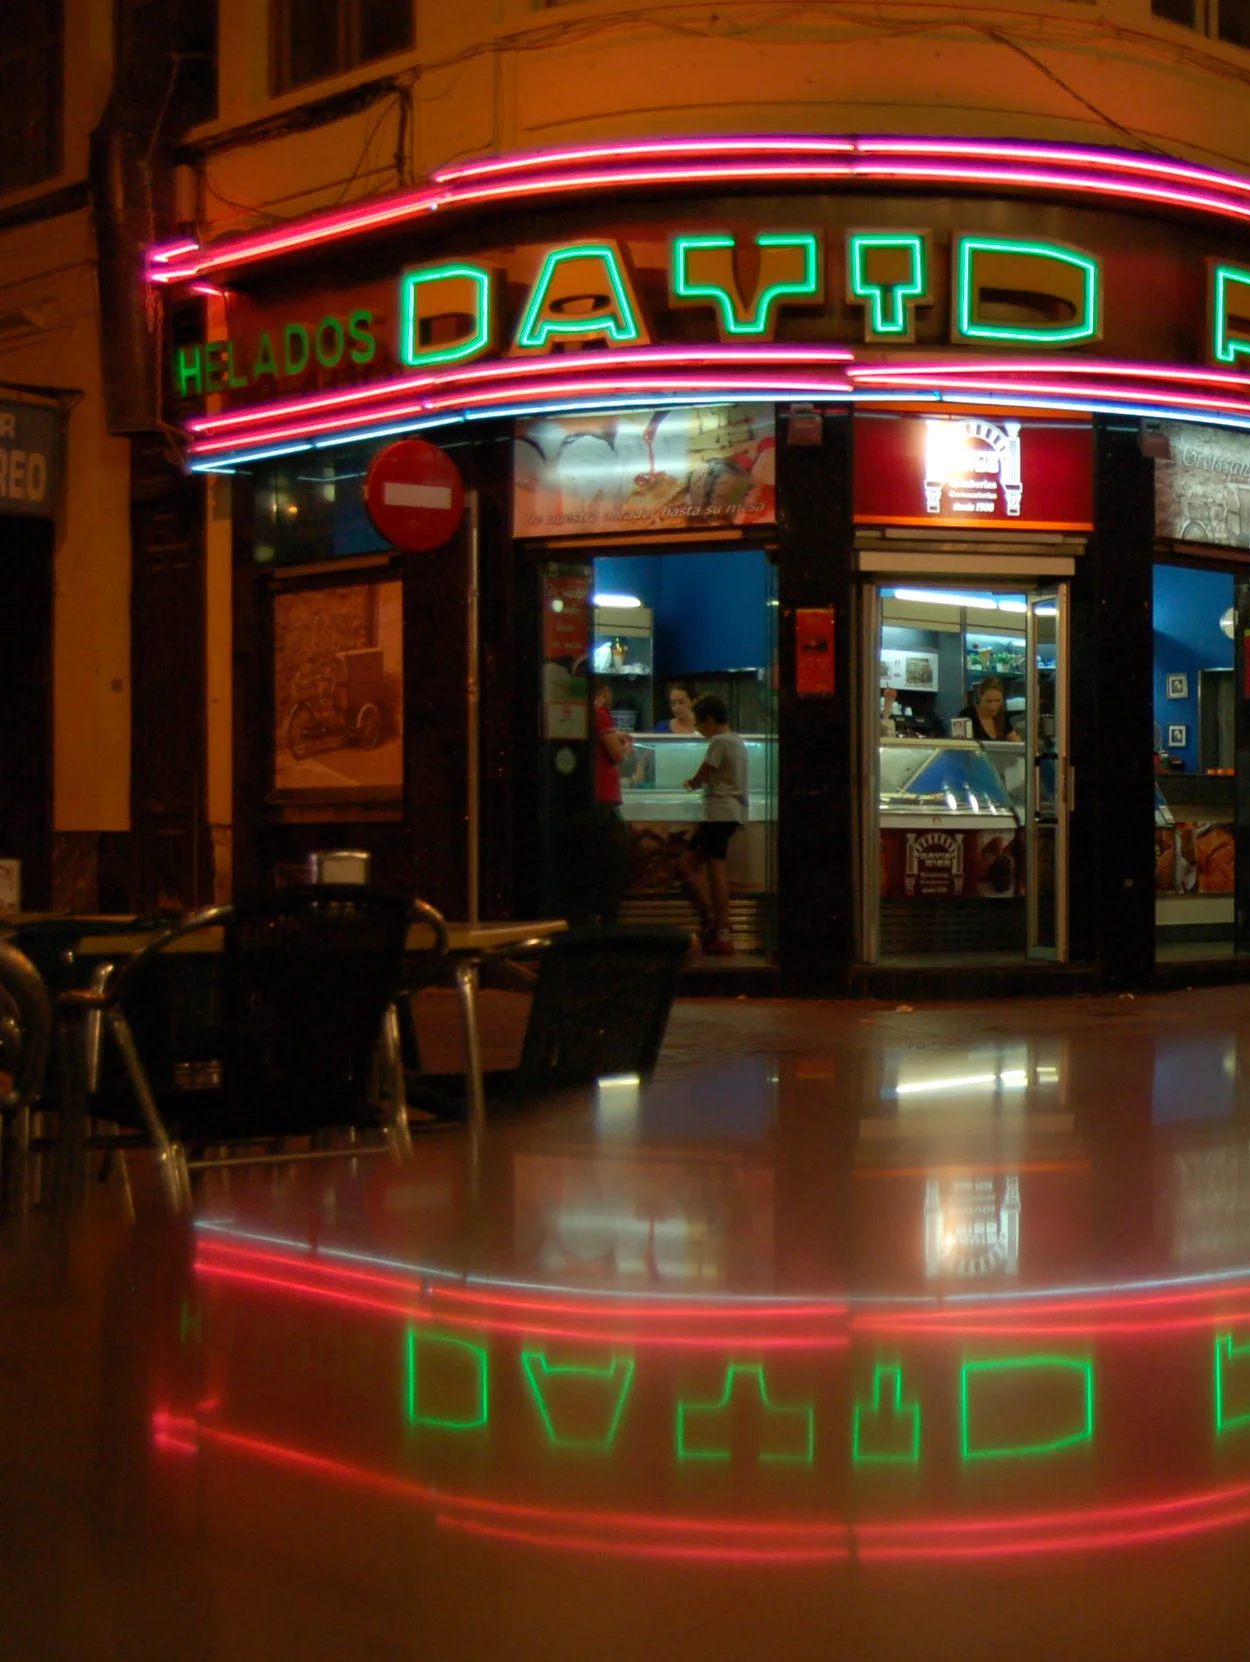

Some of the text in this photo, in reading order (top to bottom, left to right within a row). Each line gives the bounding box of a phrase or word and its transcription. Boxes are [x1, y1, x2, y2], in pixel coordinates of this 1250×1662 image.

[399, 231, 1100, 368] DAVID
[174, 309, 377, 398] HELADOS
[660, 502, 699, 519] hasta
[704, 503, 722, 516] su
